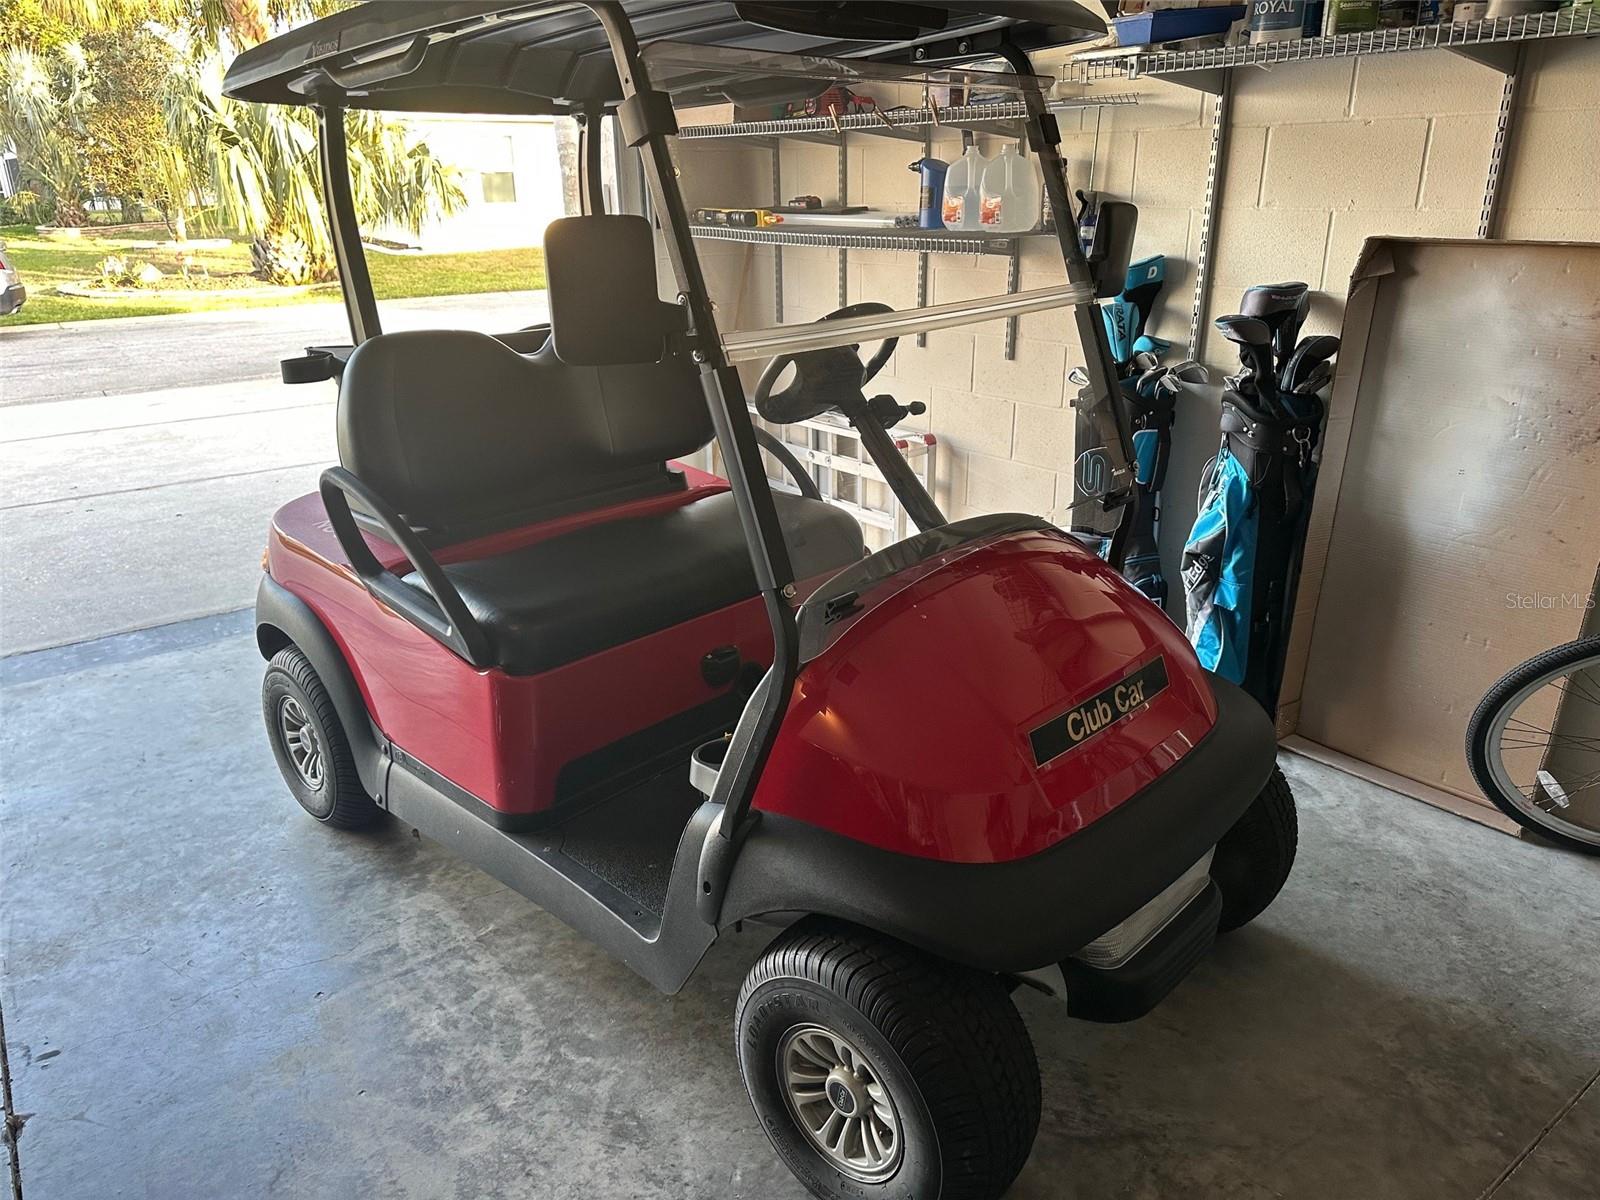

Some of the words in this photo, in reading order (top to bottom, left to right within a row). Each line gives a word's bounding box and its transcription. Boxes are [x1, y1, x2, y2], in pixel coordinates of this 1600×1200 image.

[1254, 0, 1295, 16] ROYAL
[1147, 266, 1158, 279] D
[1114, 303, 1126, 342] TRATA
[1066, 699, 1112, 741] Club
[1114, 679, 1144, 713] Car
